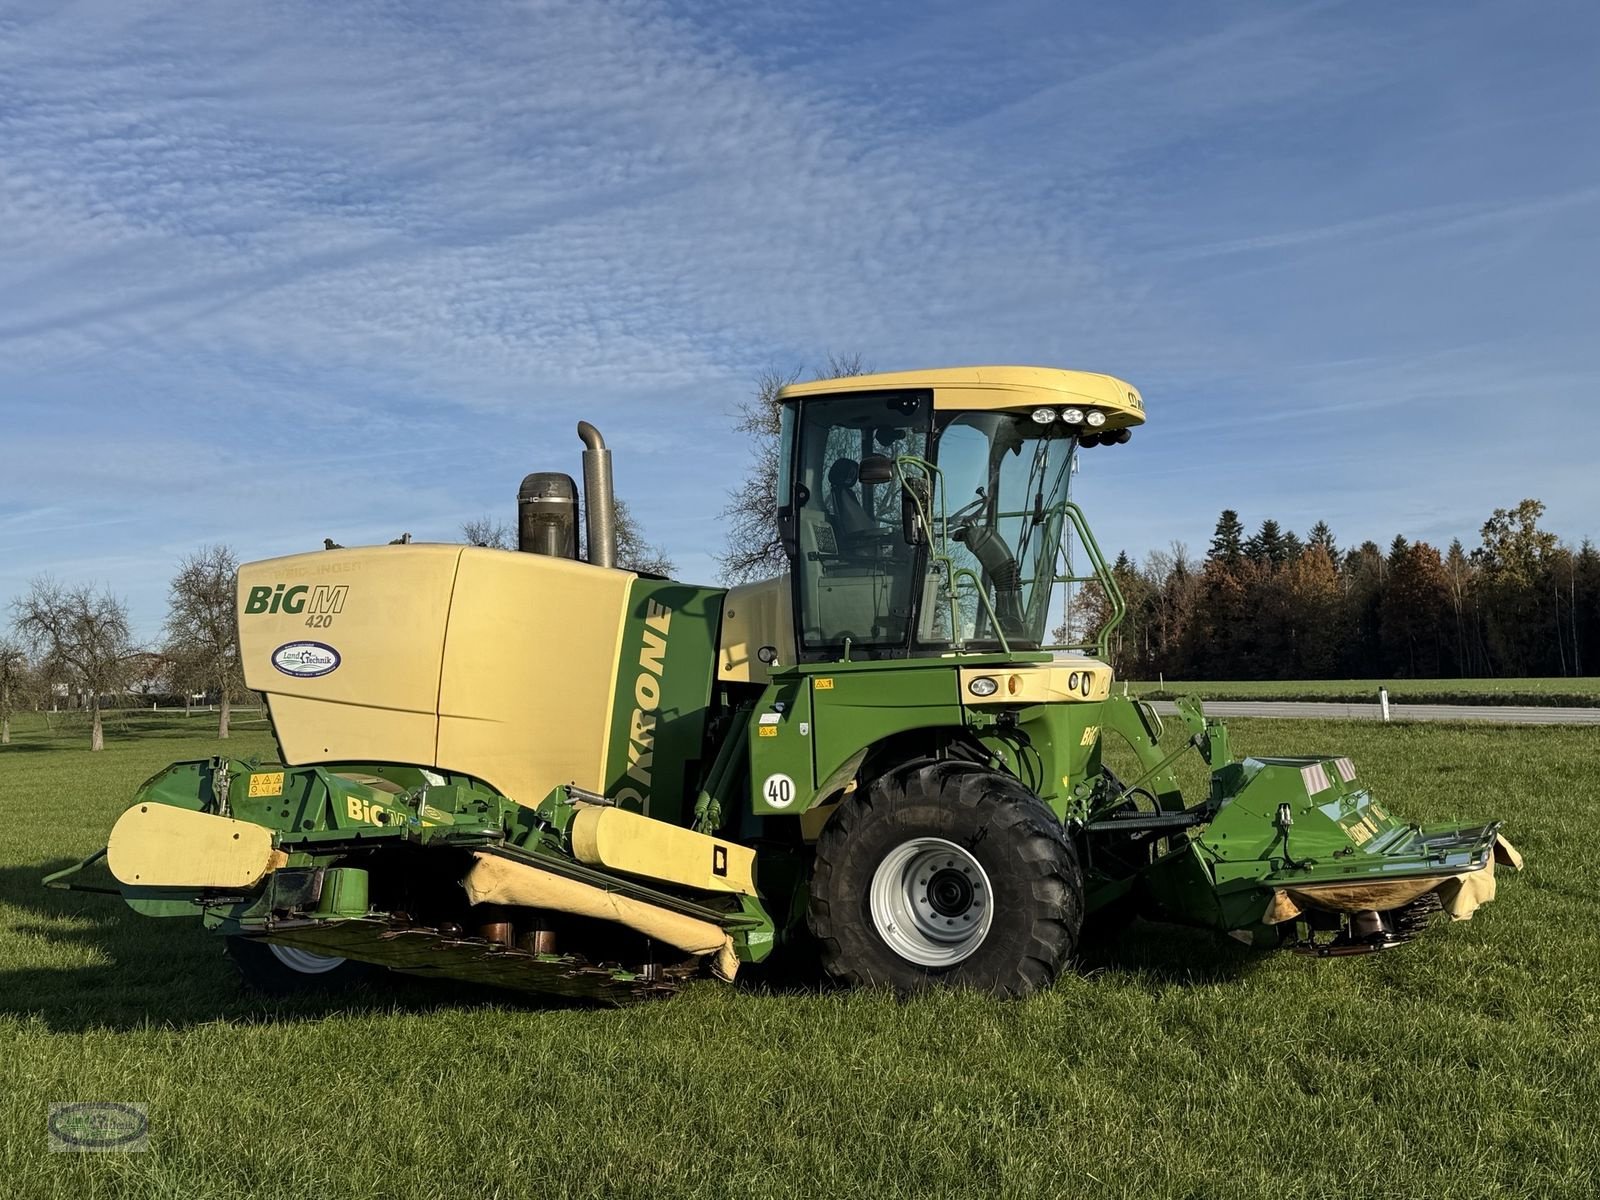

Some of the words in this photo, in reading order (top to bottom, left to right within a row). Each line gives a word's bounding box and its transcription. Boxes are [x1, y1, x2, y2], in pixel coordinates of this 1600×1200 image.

[305, 615, 332, 628] 420
[283, 652, 300, 660] Land
[305, 656, 332, 664] Technik
[627, 598, 672, 787] KRONE
[768, 779, 790, 802] 40
